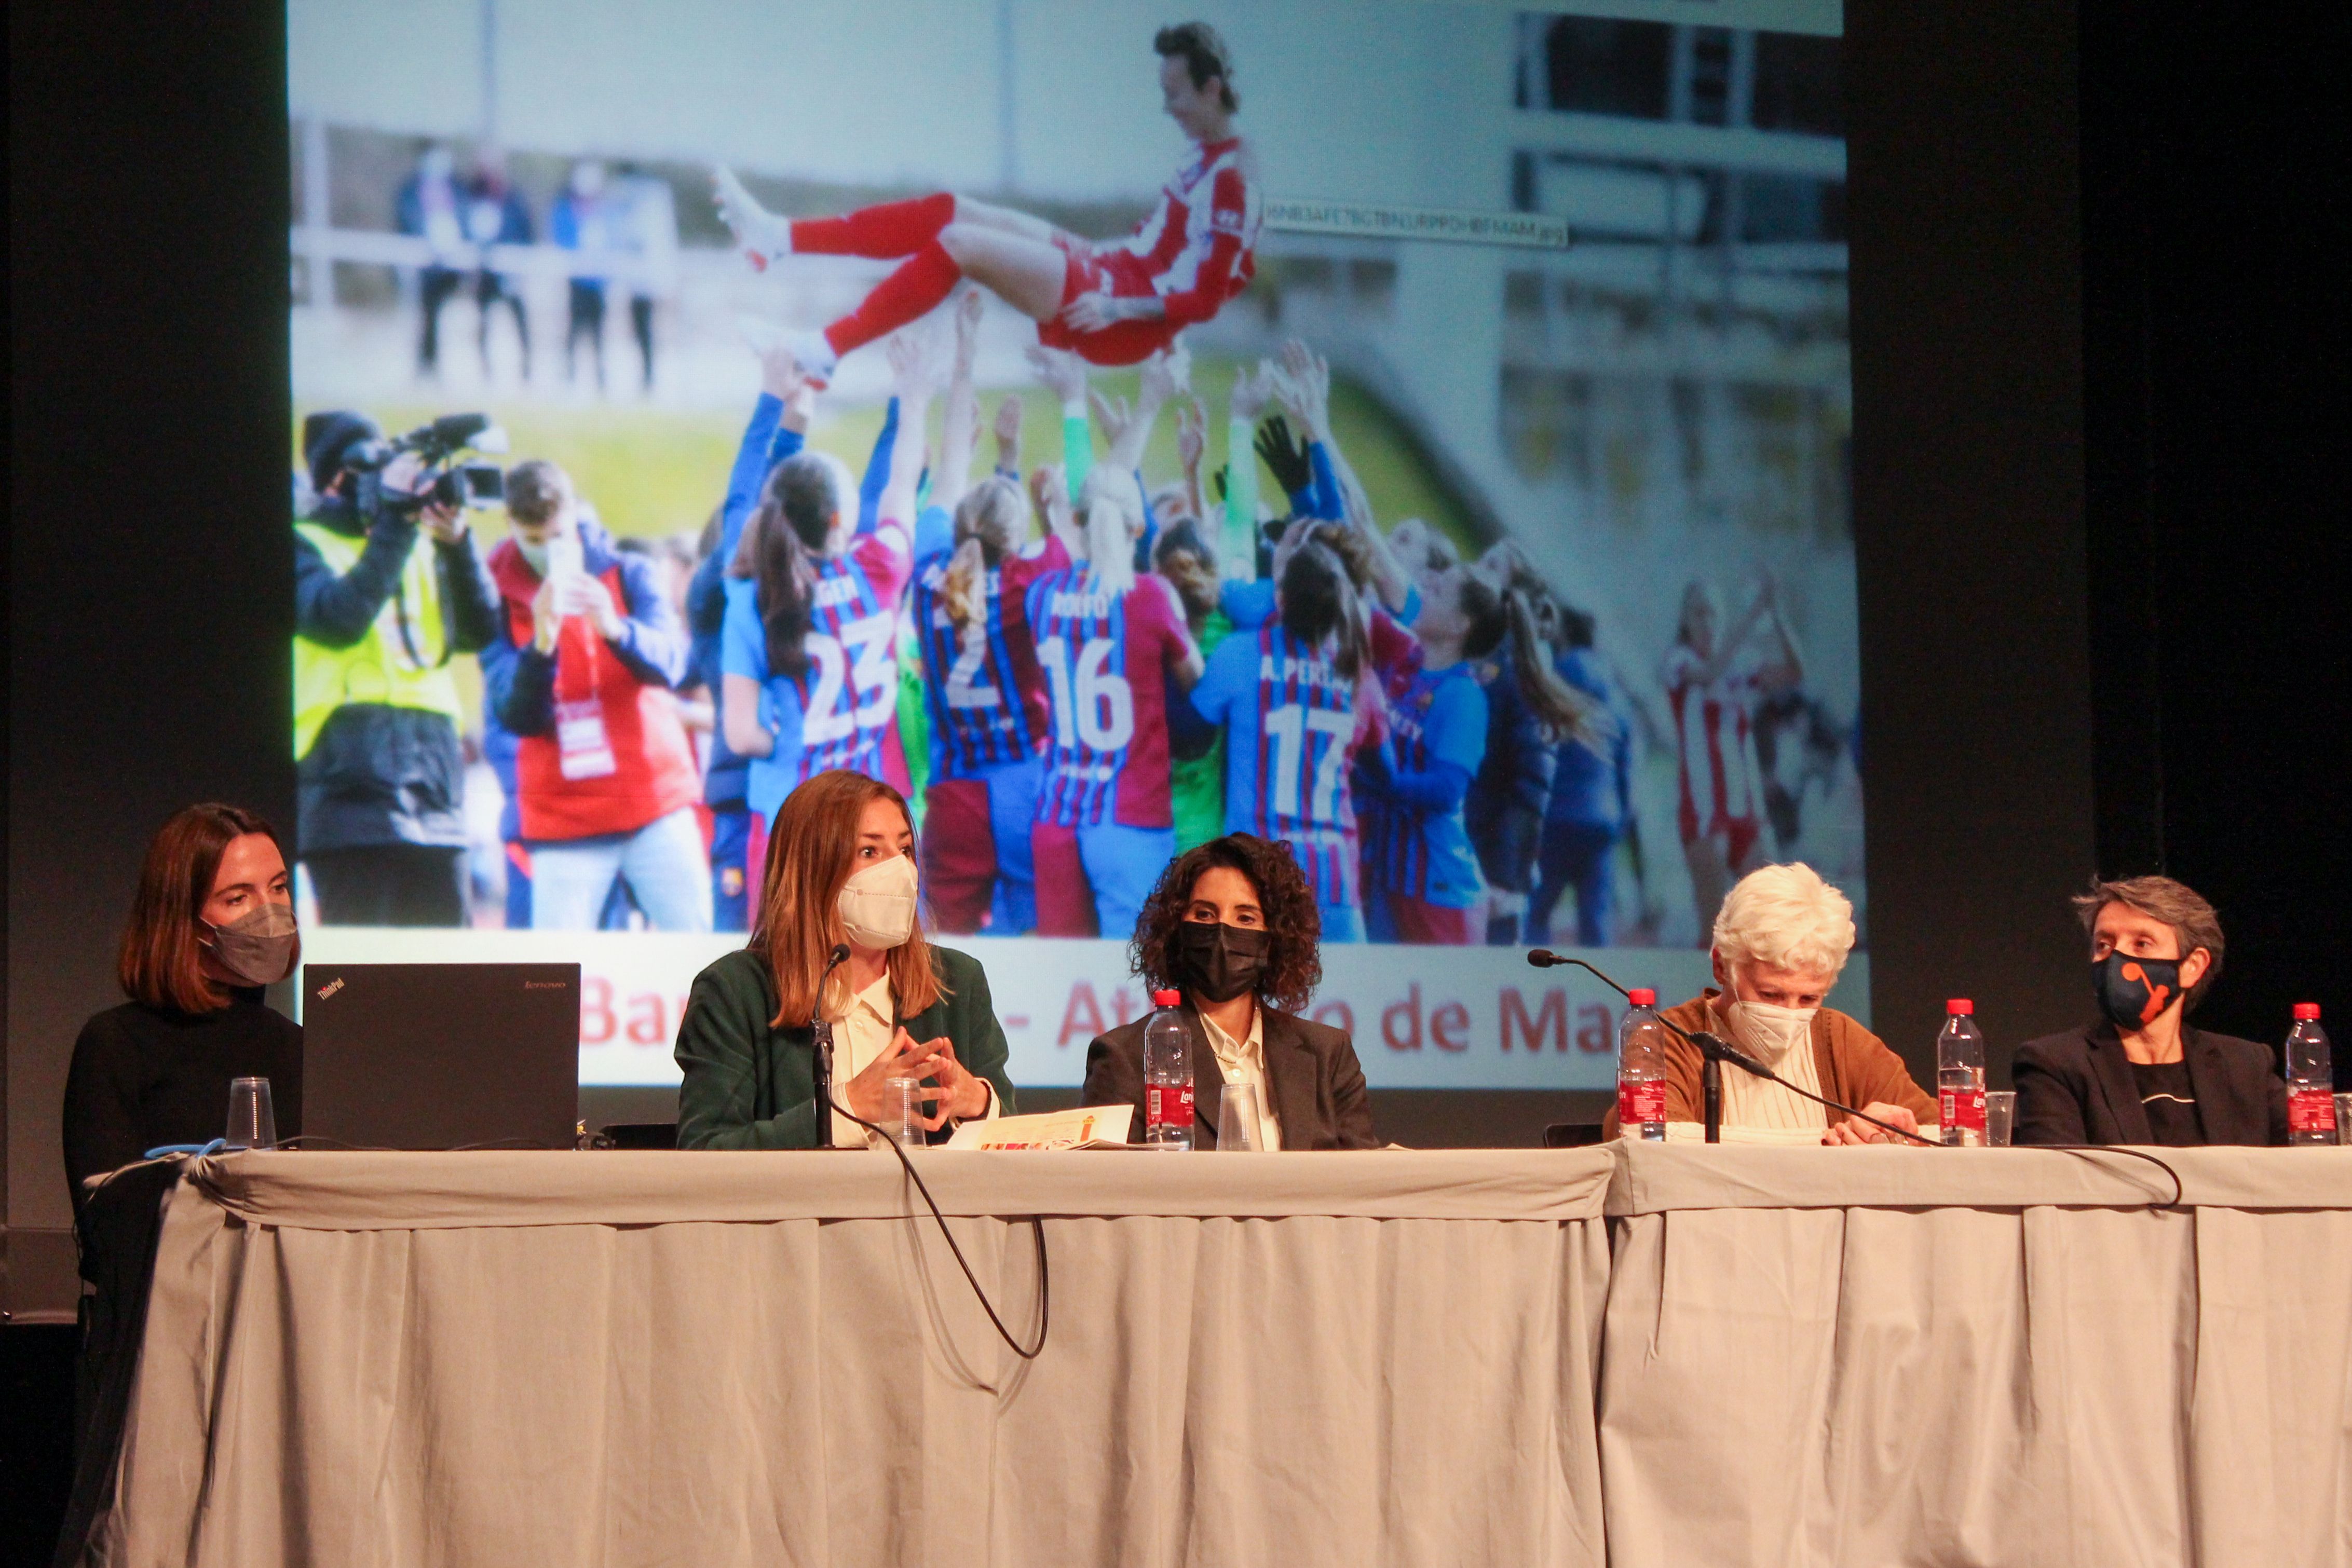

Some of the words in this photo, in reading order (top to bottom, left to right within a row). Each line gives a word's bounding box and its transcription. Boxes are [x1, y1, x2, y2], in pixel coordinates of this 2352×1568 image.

[804, 610, 898, 745] 23
[1036, 636, 1134, 751] 16
[1265, 703, 1354, 822] 17
[317, 977, 345, 1000] ThinkPad
[1381, 980, 1470, 1054] de
